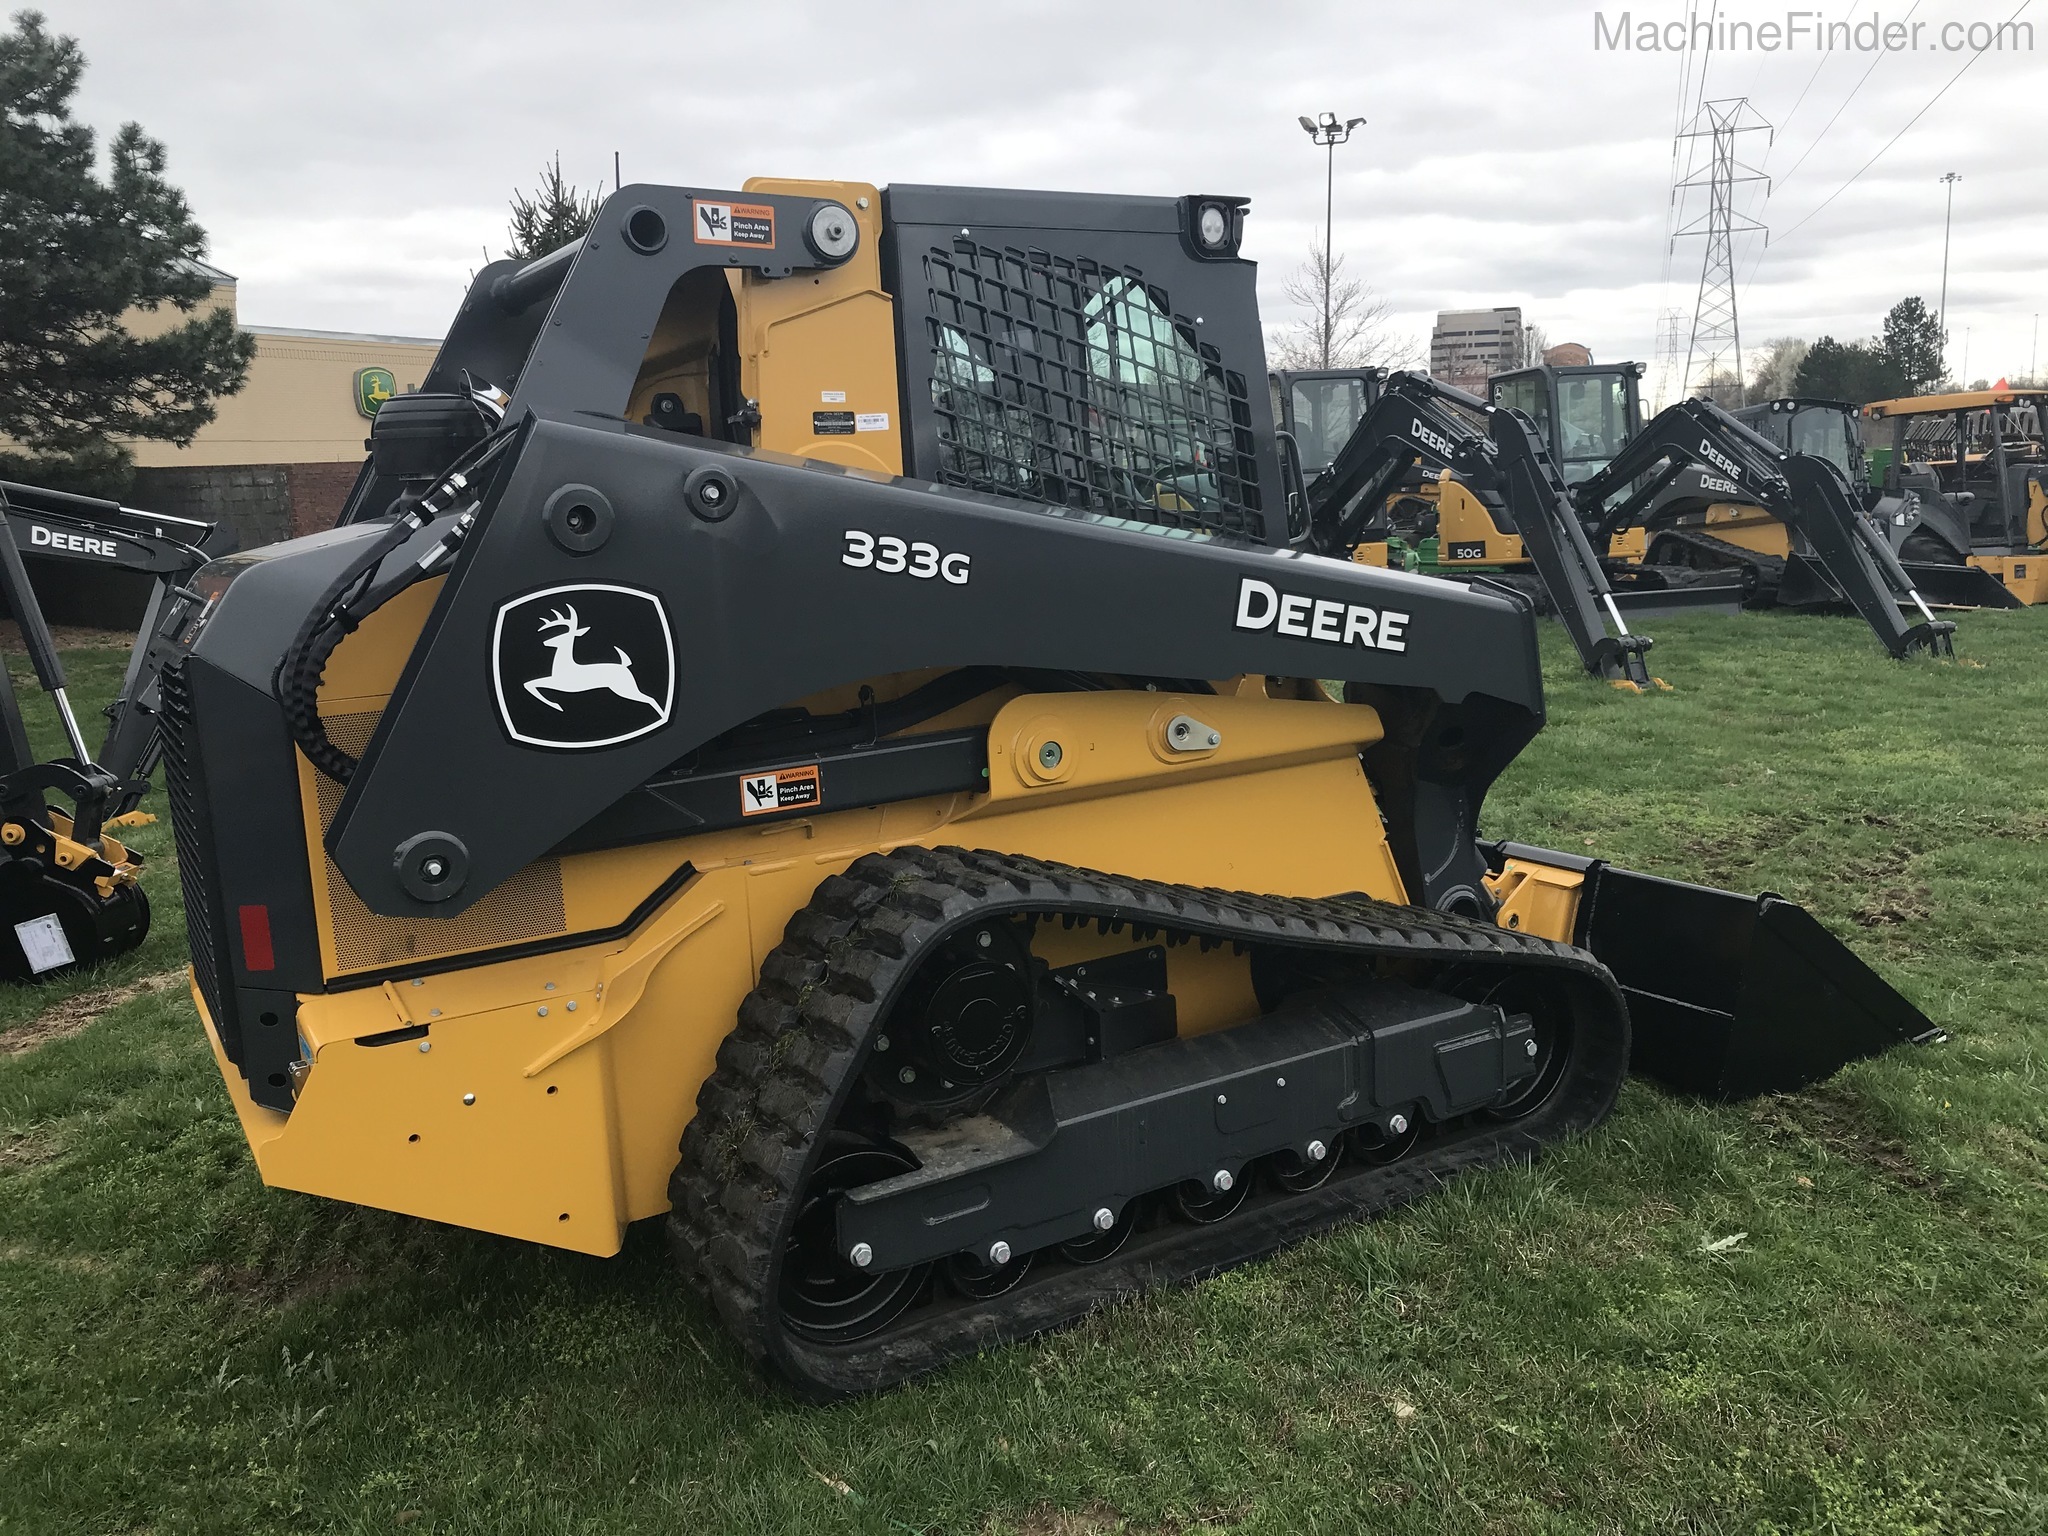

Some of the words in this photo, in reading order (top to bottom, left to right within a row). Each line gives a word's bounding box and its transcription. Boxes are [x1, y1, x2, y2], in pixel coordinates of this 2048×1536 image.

[741, 208, 770, 217] WARNING
[733, 221, 753, 230] Pinch
[753, 223, 770, 231] Area
[733, 230, 749, 239] Keep
[749, 232, 765, 240] Away
[1411, 417, 1455, 460] DEERE
[1699, 438, 1742, 480] DEERE
[1422, 469, 1441, 480] DEE
[1699, 474, 1738, 494] DEERE
[31, 525, 117, 558] DEERE
[842, 530, 971, 585] 333G
[1456, 548, 1482, 559] 50G
[1235, 577, 1410, 652] DEERE
[785, 769, 815, 779] WARNING
[779, 786, 798, 794] Pinch
[798, 783, 815, 792] Area
